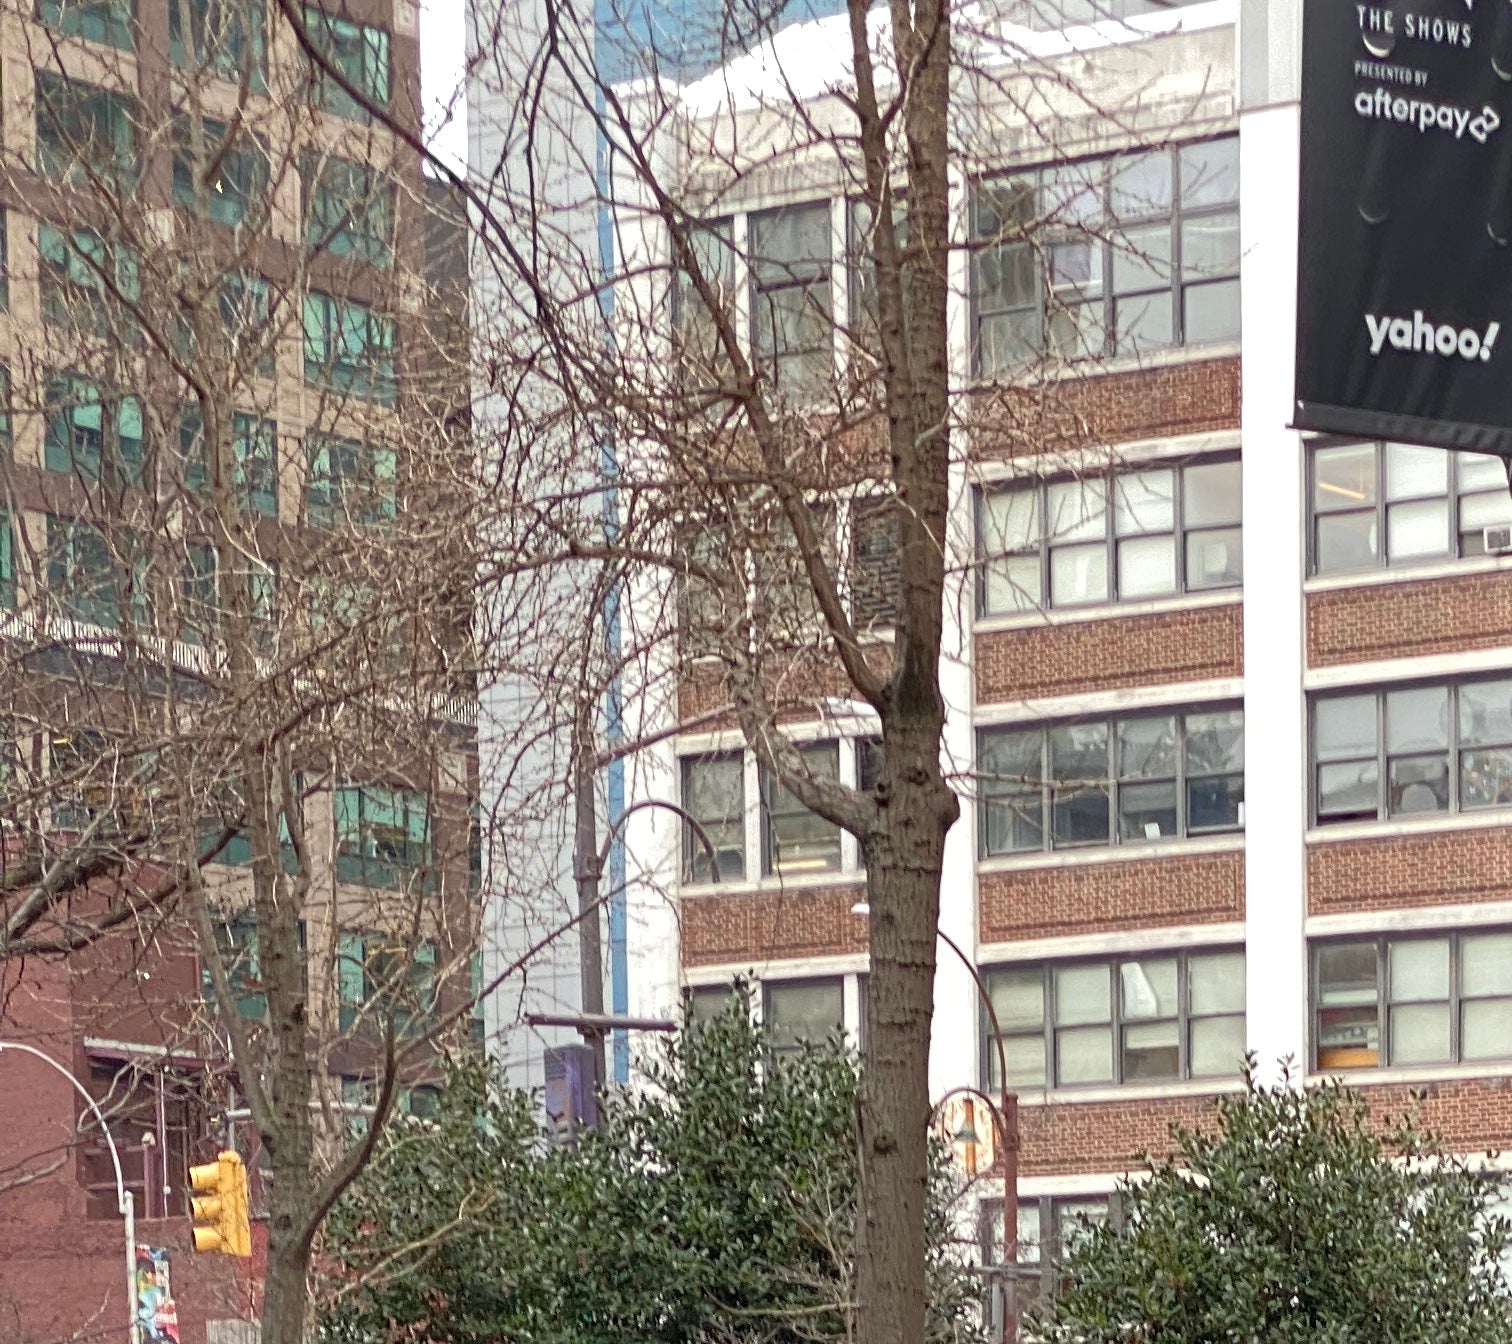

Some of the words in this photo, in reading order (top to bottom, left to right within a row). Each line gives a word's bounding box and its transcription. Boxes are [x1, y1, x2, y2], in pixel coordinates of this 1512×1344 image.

[1356, 5, 1394, 34] THE
[1404, 13, 1472, 48] SHOWS
[1414, 71, 1428, 87] BY
[1354, 87, 1471, 140] afterpay
[1365, 310, 1500, 361] yahoo!
